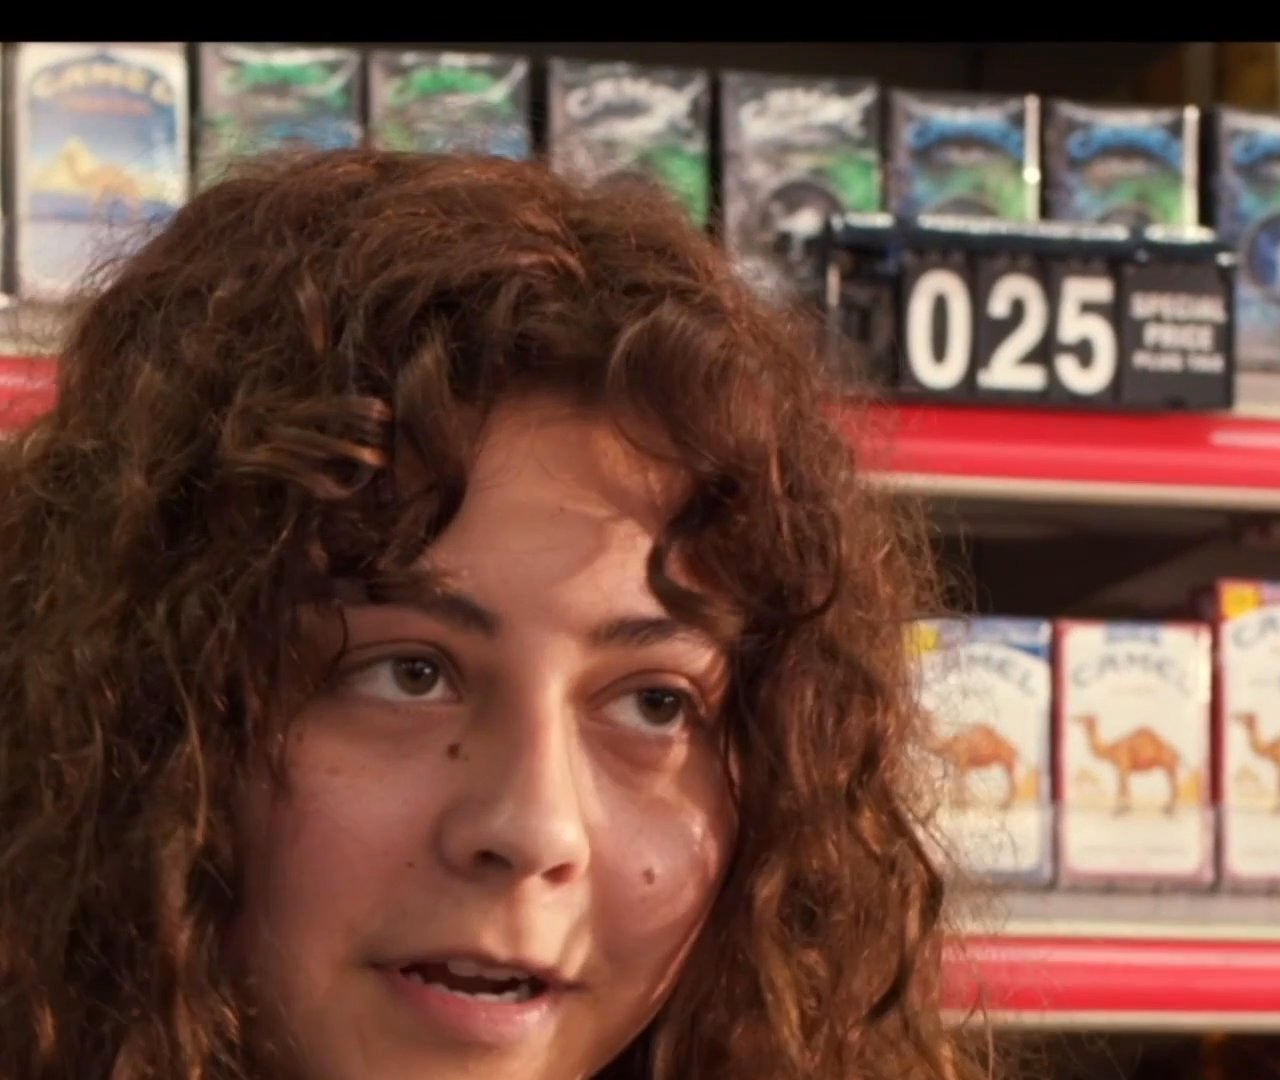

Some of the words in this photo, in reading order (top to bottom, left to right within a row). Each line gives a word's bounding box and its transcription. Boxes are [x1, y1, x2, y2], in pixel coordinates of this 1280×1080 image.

[1130, 291, 1228, 323] SPECIAL
[905, 269, 1119, 396] 025
[1143, 321, 1215, 351] PRICE
[1131, 350, 1184, 372] PLUS
[1071, 648, 1192, 700] CAMEL
